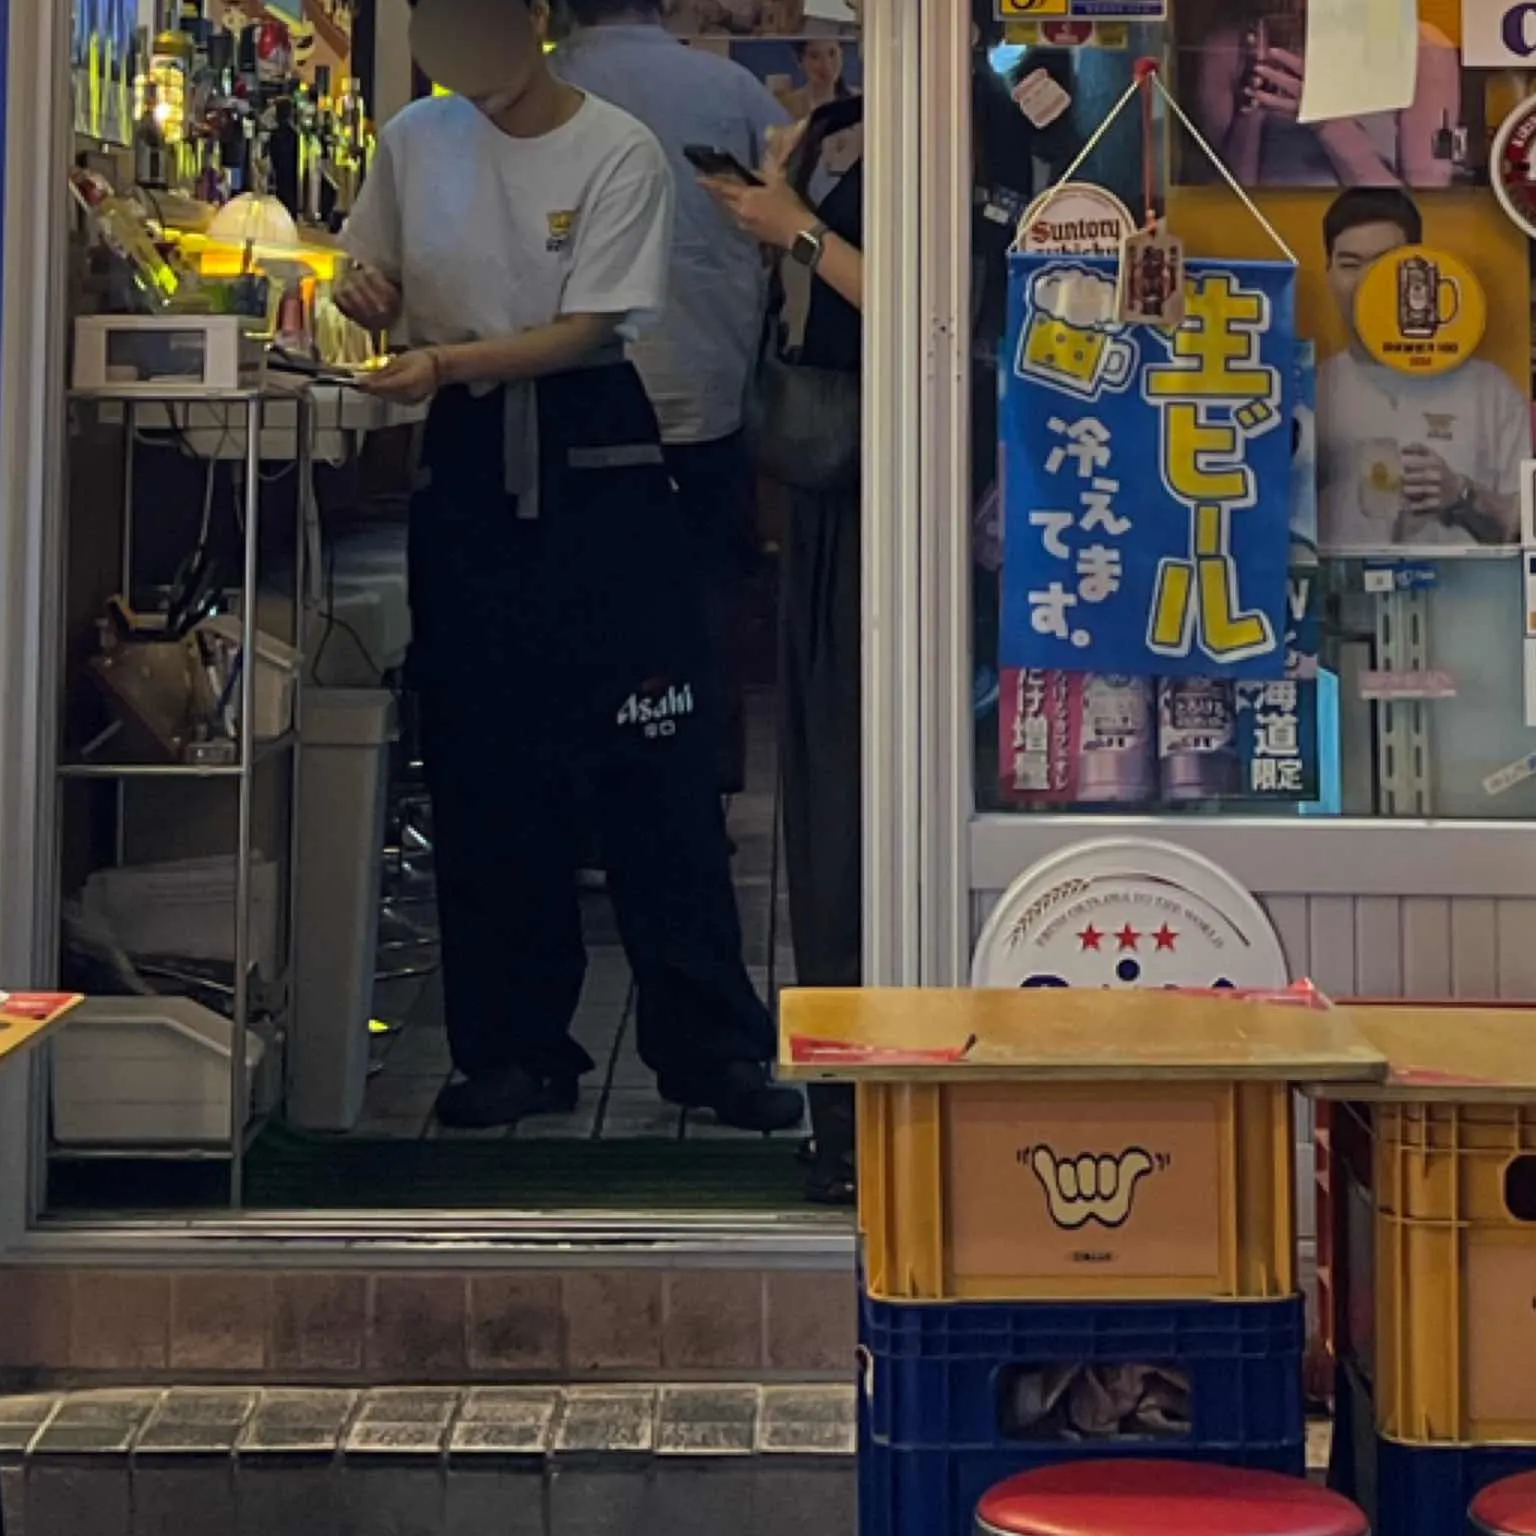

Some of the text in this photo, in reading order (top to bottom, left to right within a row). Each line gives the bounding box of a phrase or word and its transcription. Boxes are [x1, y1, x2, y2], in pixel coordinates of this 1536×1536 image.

[1030, 218, 1121, 242] Suntory
[1142, 272, 1276, 666] 生ビール
[616, 683, 695, 726] Asahi
